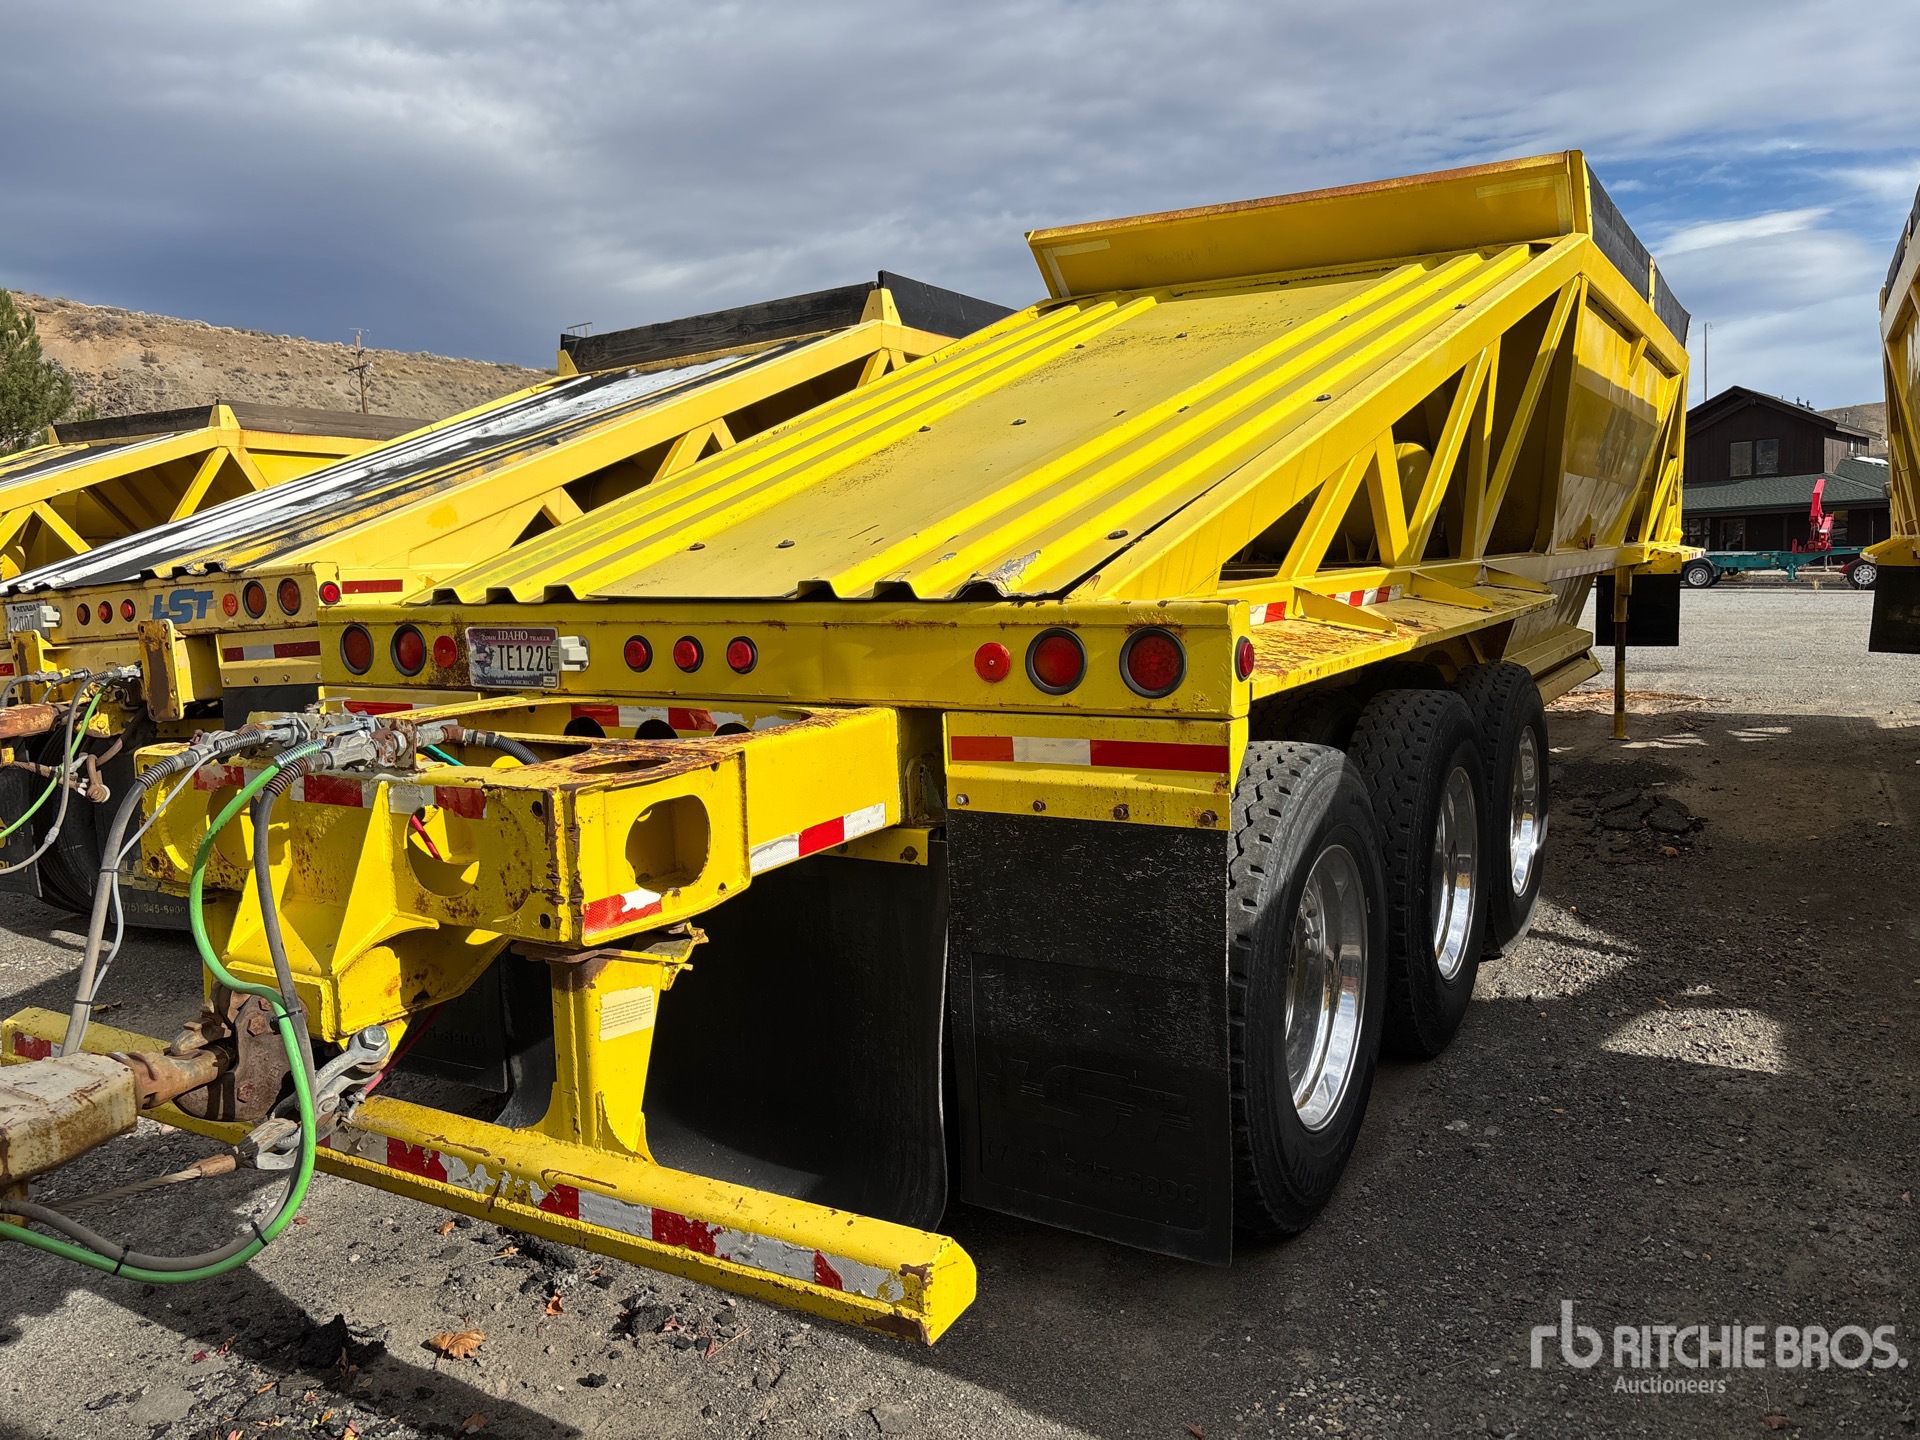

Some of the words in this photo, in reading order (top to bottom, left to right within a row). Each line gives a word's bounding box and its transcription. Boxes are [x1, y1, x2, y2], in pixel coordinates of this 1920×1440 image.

[152, 589, 214, 624] LST
[498, 631, 528, 641] IDAHO
[143, 904, 186, 914] 345-6900
